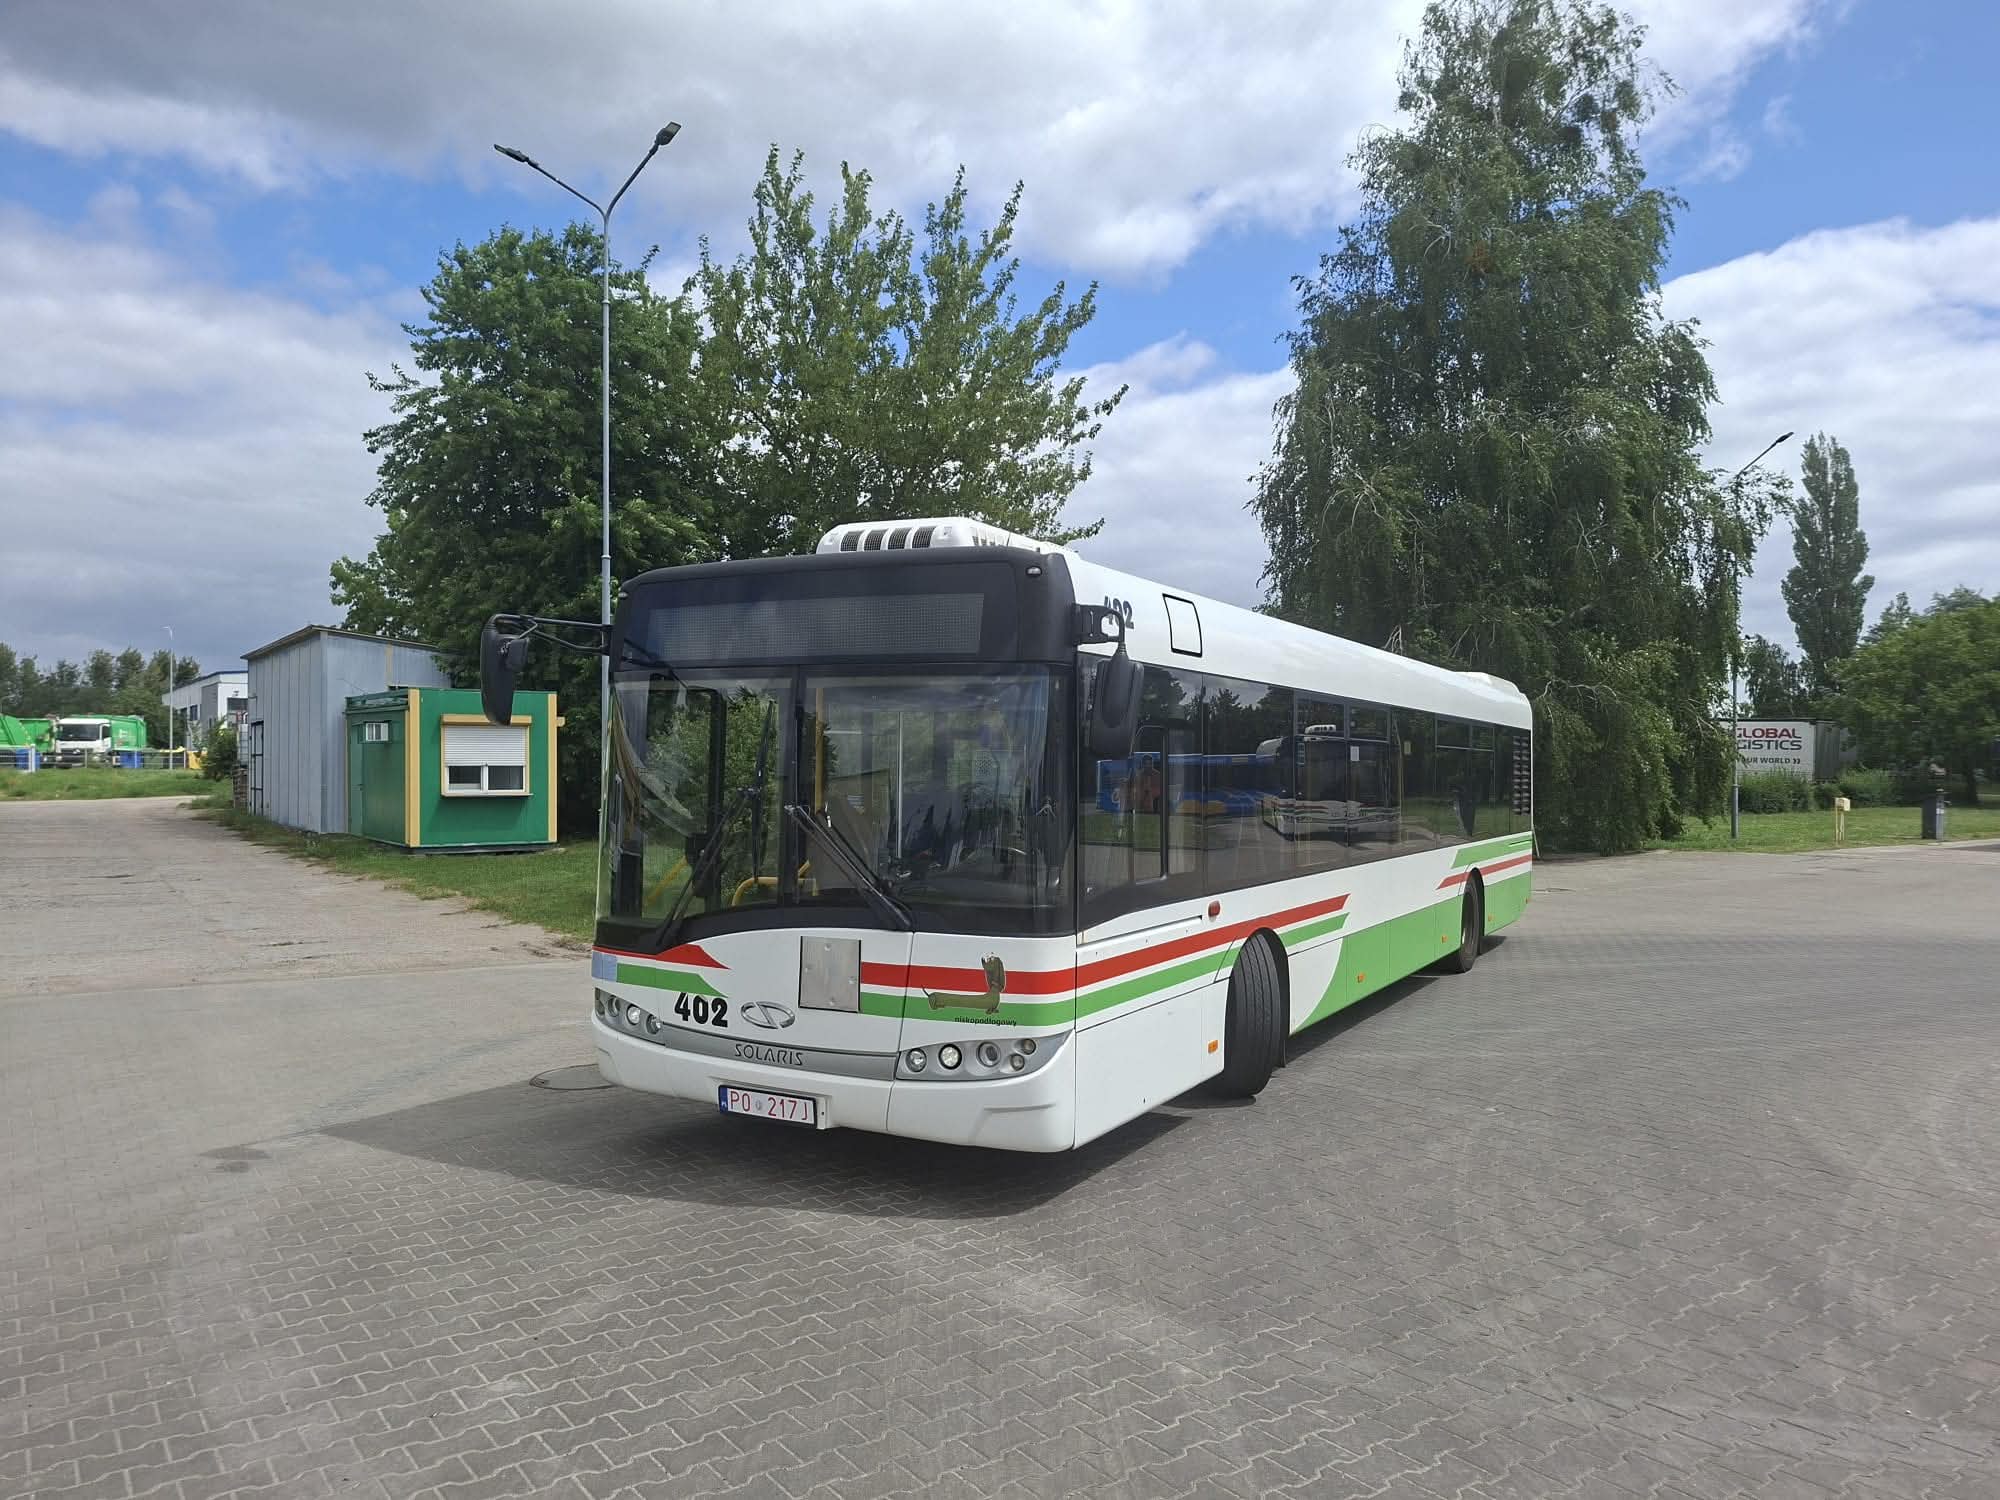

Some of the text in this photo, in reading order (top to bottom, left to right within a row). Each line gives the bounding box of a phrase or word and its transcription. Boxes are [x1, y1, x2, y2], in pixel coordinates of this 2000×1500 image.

[1737, 740, 1802, 750] GISTICS
[674, 992, 728, 1028] 402
[734, 1043, 803, 1066] SOLARIS
